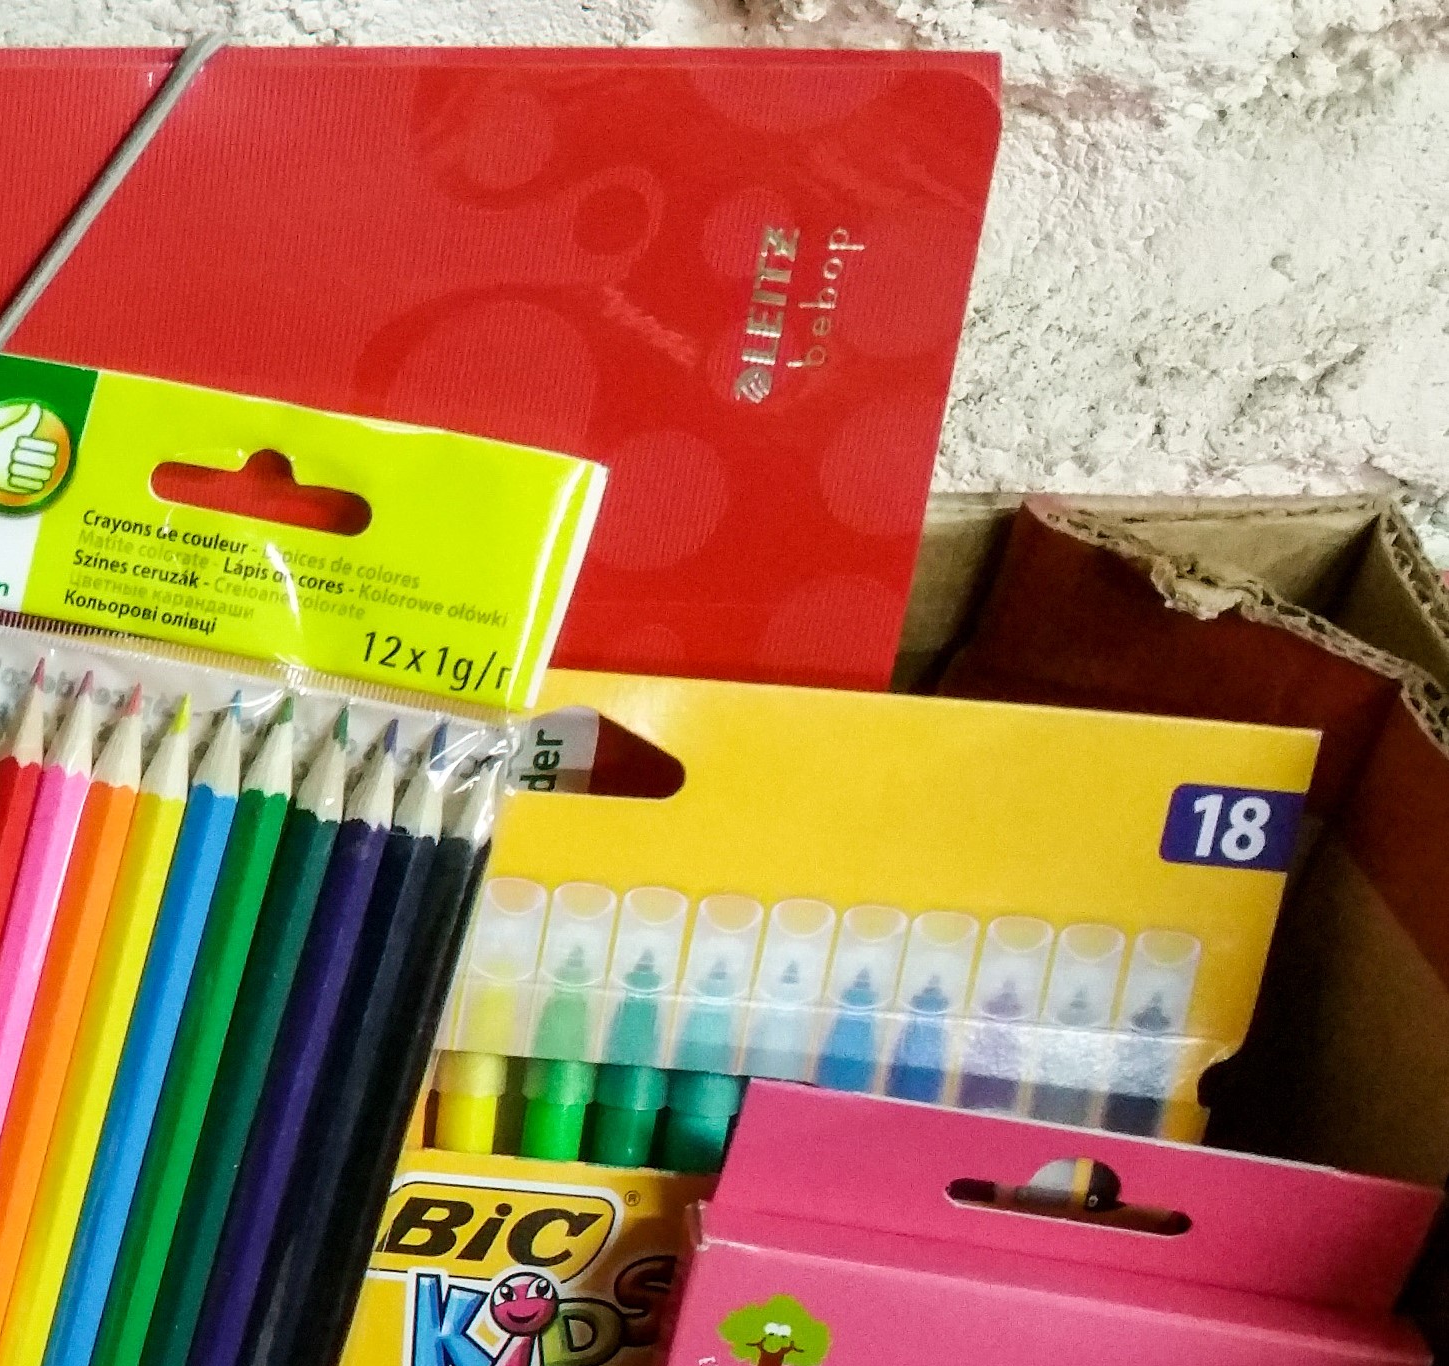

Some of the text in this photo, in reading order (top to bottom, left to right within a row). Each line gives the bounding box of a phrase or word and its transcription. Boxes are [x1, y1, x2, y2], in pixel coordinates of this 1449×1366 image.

[741, 226, 801, 366] LEITZ
[786, 226, 865, 368] bebop
[73, 549, 200, 588] Színes ceruzák
[78, 529, 509, 629] Matite colorate Lápis cores Kolorowe ołówki
[83, 509, 152, 538] Crayons
[181, 530, 248, 556] couleur
[330, 556, 353, 575] de
[355, 560, 421, 589] colores
[63, 587, 218, 635] Кольорові олівці
[68, 569, 255, 622] Цветные карандаши
[1190, 791, 1273, 864] 18
